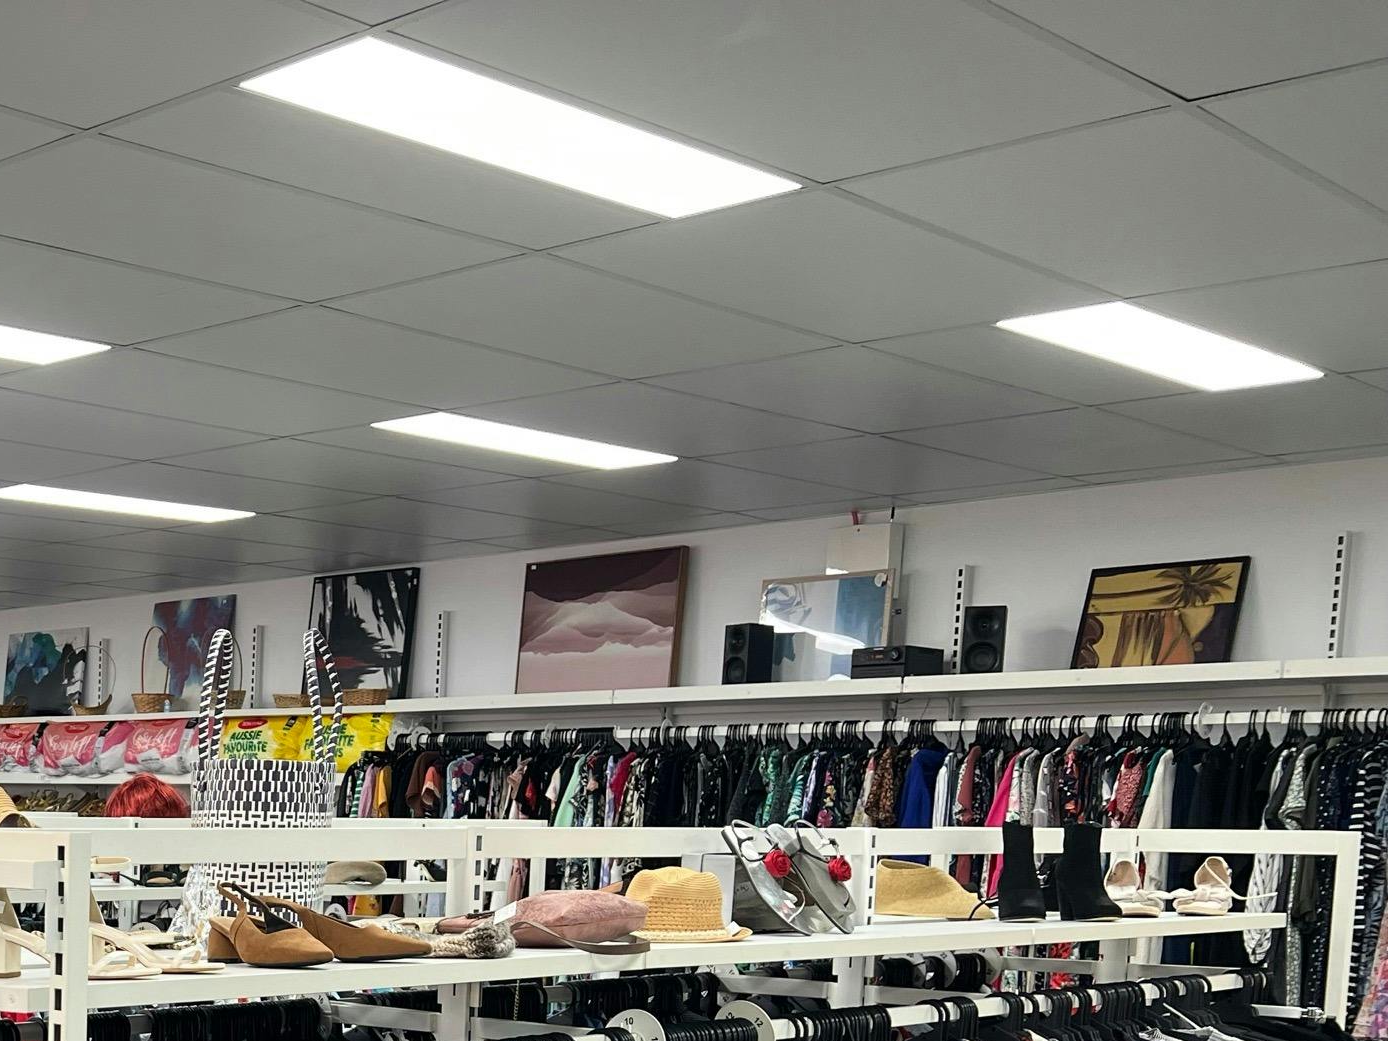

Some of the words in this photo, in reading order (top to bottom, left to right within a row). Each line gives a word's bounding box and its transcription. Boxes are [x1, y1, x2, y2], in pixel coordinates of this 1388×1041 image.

[229, 730, 263, 742] AUSSIE
[223, 740, 268, 754] FAVOURITE
[624, 1016, 635, 1026] 10
[754, 1017, 765, 1028] 12
